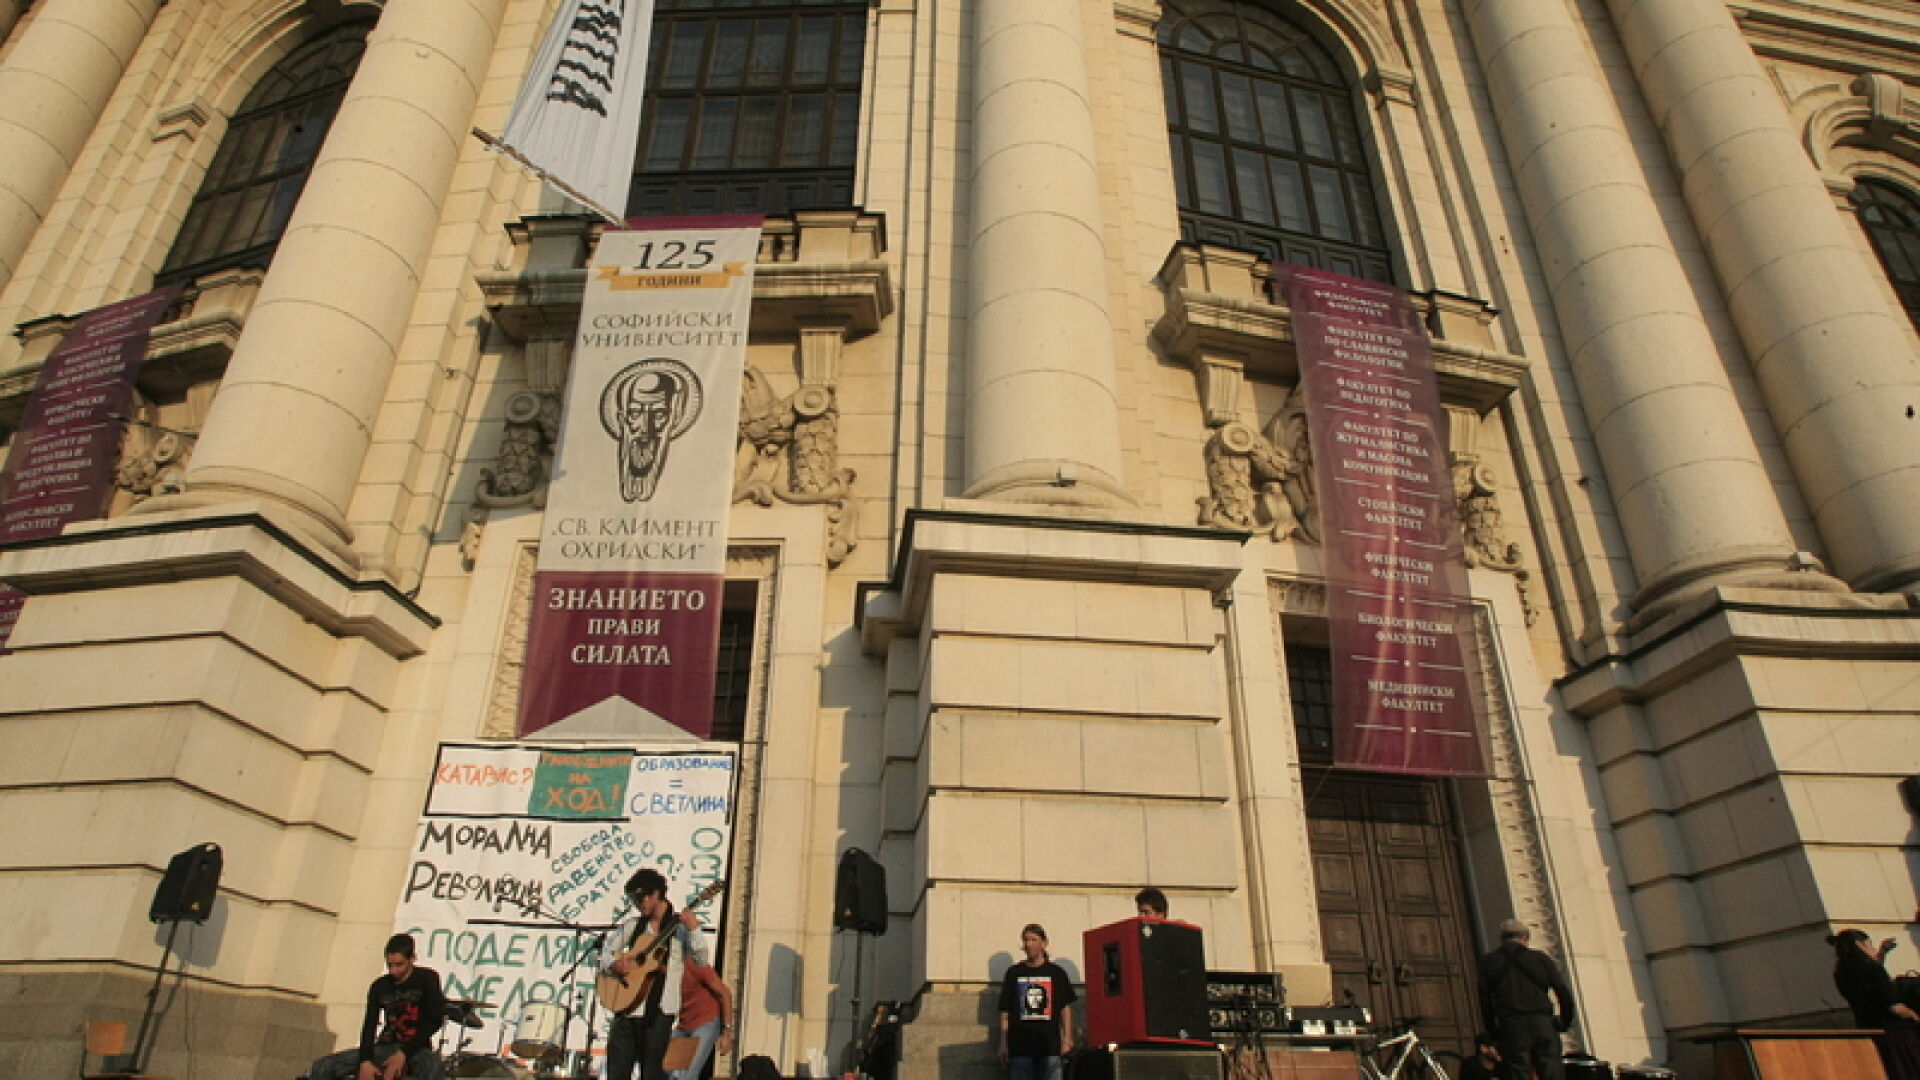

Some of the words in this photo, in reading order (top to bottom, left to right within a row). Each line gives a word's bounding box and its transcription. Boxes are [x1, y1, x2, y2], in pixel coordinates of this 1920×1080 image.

[633, 239, 717, 270] 125
[592, 310, 733, 330] СОФИЙСКИ
[582, 330, 743, 347] УНИВЕРСИТЕТ
[599, 518, 720, 538] КЛИМЕНТ
[548, 587, 706, 611] ЗНАНИЕТО
[587, 618, 661, 636] ПРАВИ
[570, 644, 671, 666] СИЛАТА
[420, 820, 551, 859] МОРАЛНА
